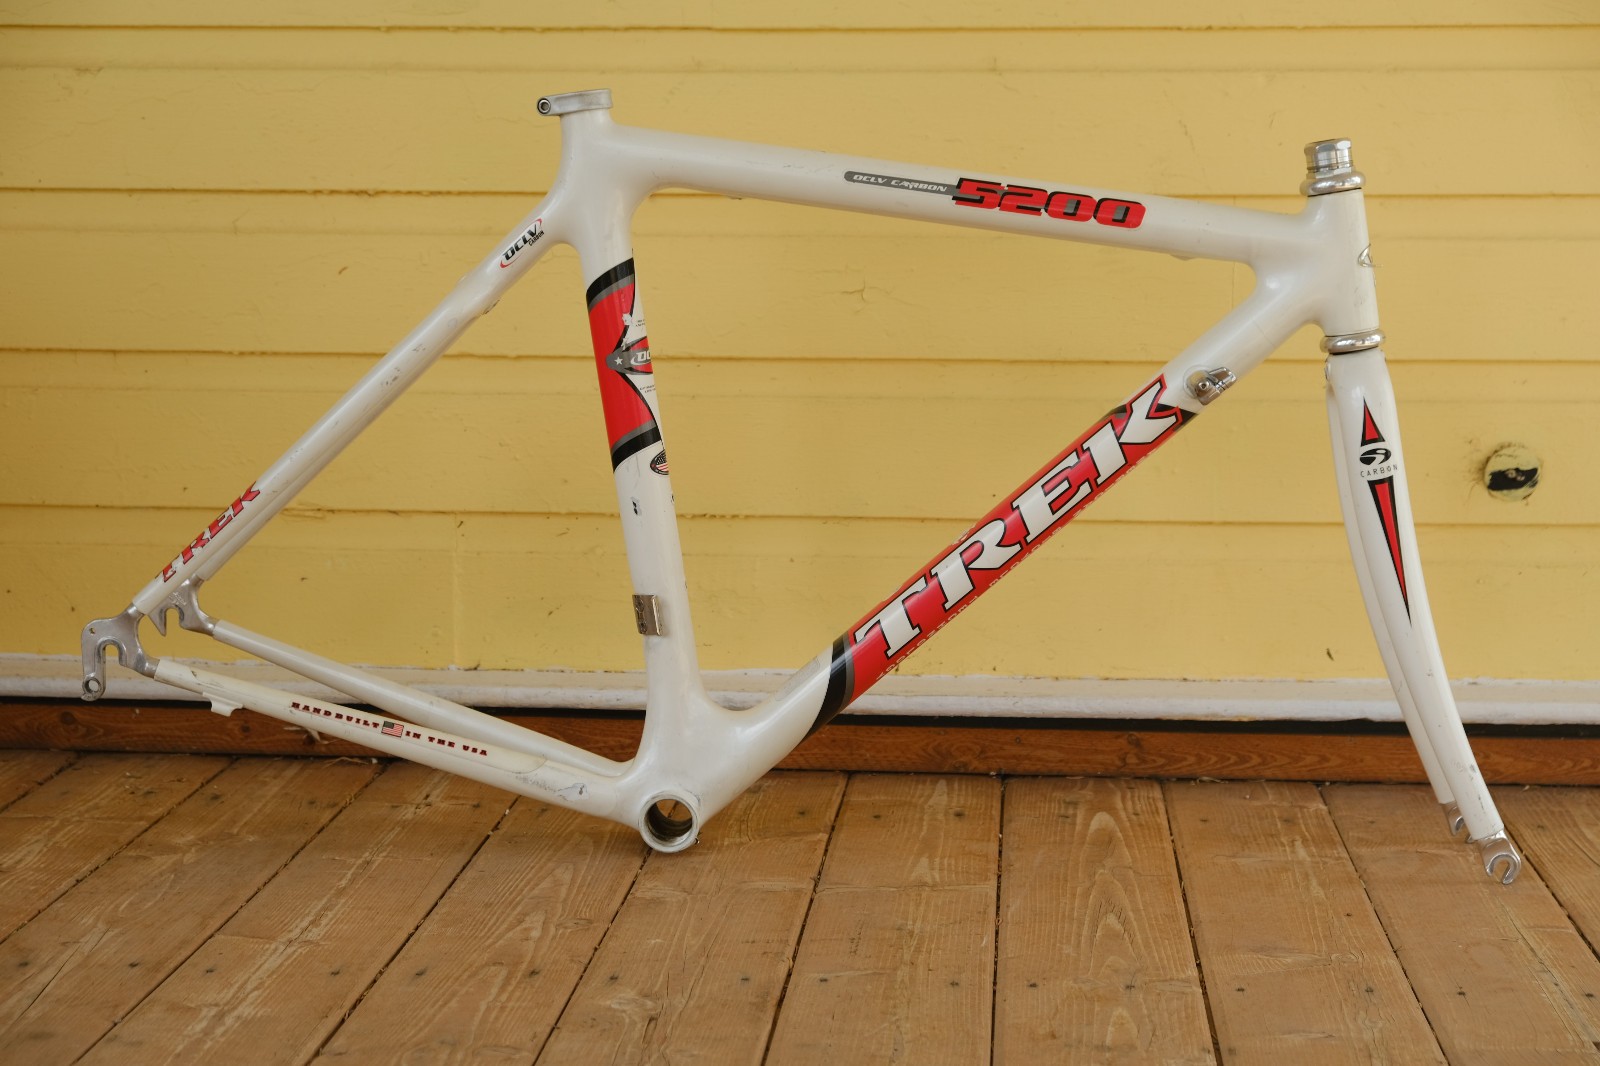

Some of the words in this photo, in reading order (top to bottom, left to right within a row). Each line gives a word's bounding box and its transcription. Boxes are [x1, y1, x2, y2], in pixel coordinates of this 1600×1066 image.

[852, 173, 887, 185] OCLV
[890, 177, 948, 192] CARBON
[952, 177, 1146, 229] 5200
[502, 224, 537, 261] OCLV
[528, 230, 545, 246] CARBON
[1360, 463, 1398, 478] CARBON
[154, 480, 261, 583] TREK
[853, 377, 1178, 659] TREK
[290, 701, 380, 729] HANDBUILT
[405, 730, 421, 740] IN
[427, 736, 455, 748] THE
[462, 744, 488, 756] USA
